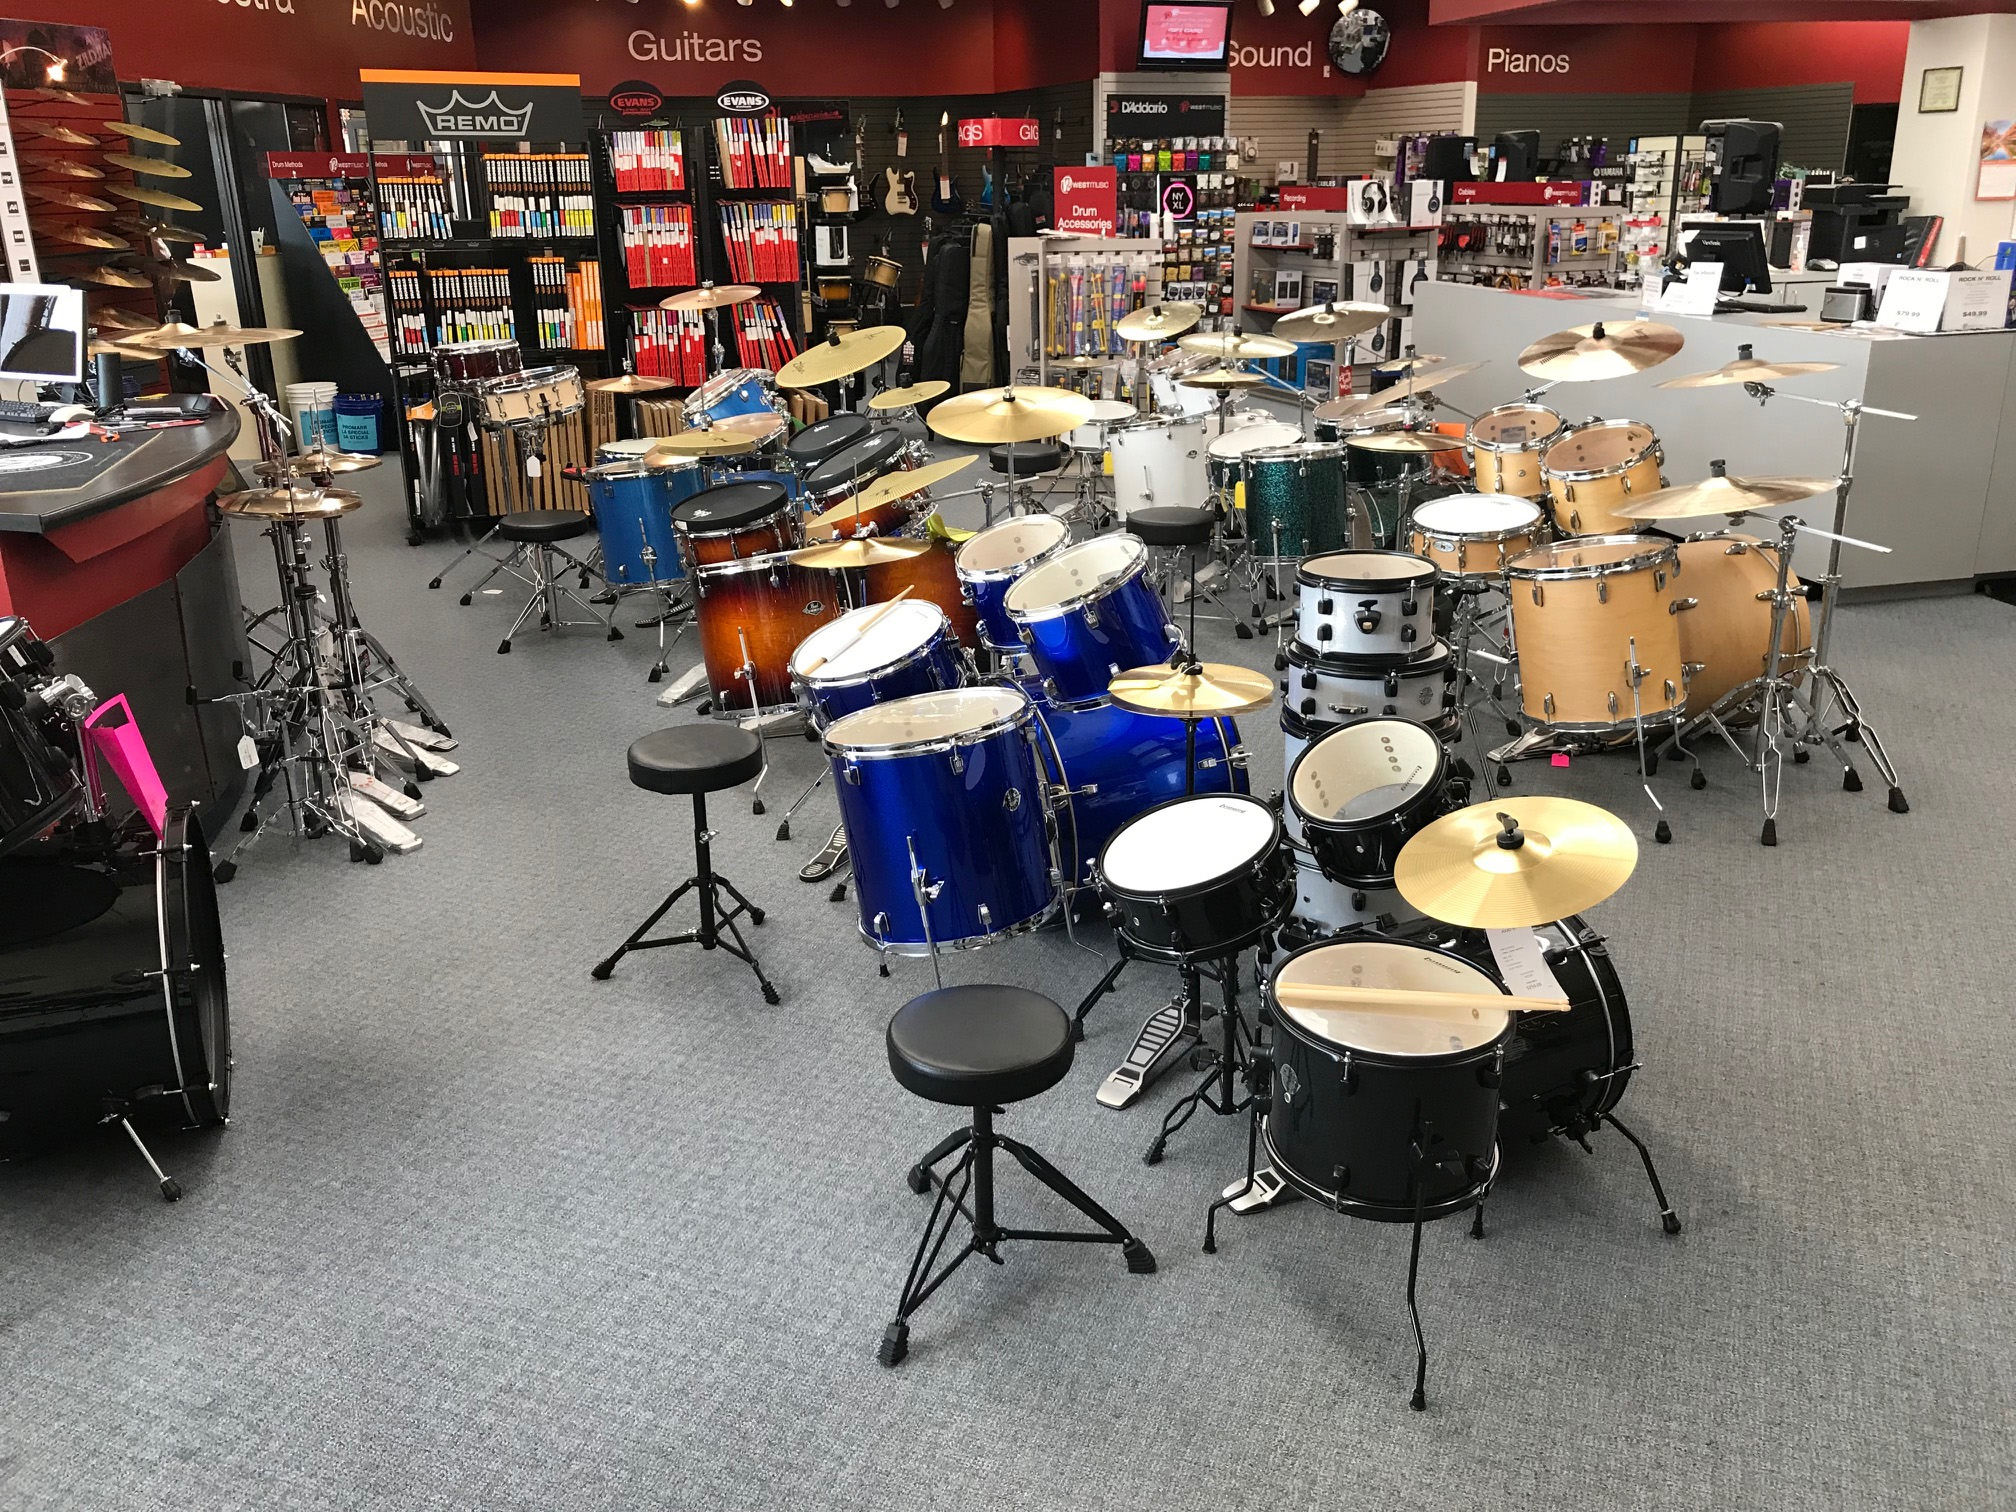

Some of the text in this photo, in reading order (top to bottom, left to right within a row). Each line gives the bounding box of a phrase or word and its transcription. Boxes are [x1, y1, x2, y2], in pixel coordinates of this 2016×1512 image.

[352, 0, 454, 42] Acoustic
[628, 31, 763, 62] Guitars
[1229, 41, 1312, 67] Sound
[1488, 49, 1570, 73] Pianos
[617, 98, 655, 107] EVANS
[723, 97, 763, 106] EVANS
[1121, 101, 1168, 114] D'Addario
[436, 115, 518, 131] REMO
[1020, 125, 1039, 140] GIG
[272, 160, 284, 168] Drum
[1601, 167, 1623, 177] YAMAHA
[1172, 192, 1184, 201] NY
[1458, 188, 1476, 196] Cables
[1283, 193, 1307, 204] Recording
[1072, 205, 1098, 216] Drum
[1172, 201, 1184, 209] XL
[1058, 217, 1112, 230] Accessories
[1962, 310, 1988, 318] $49.99
